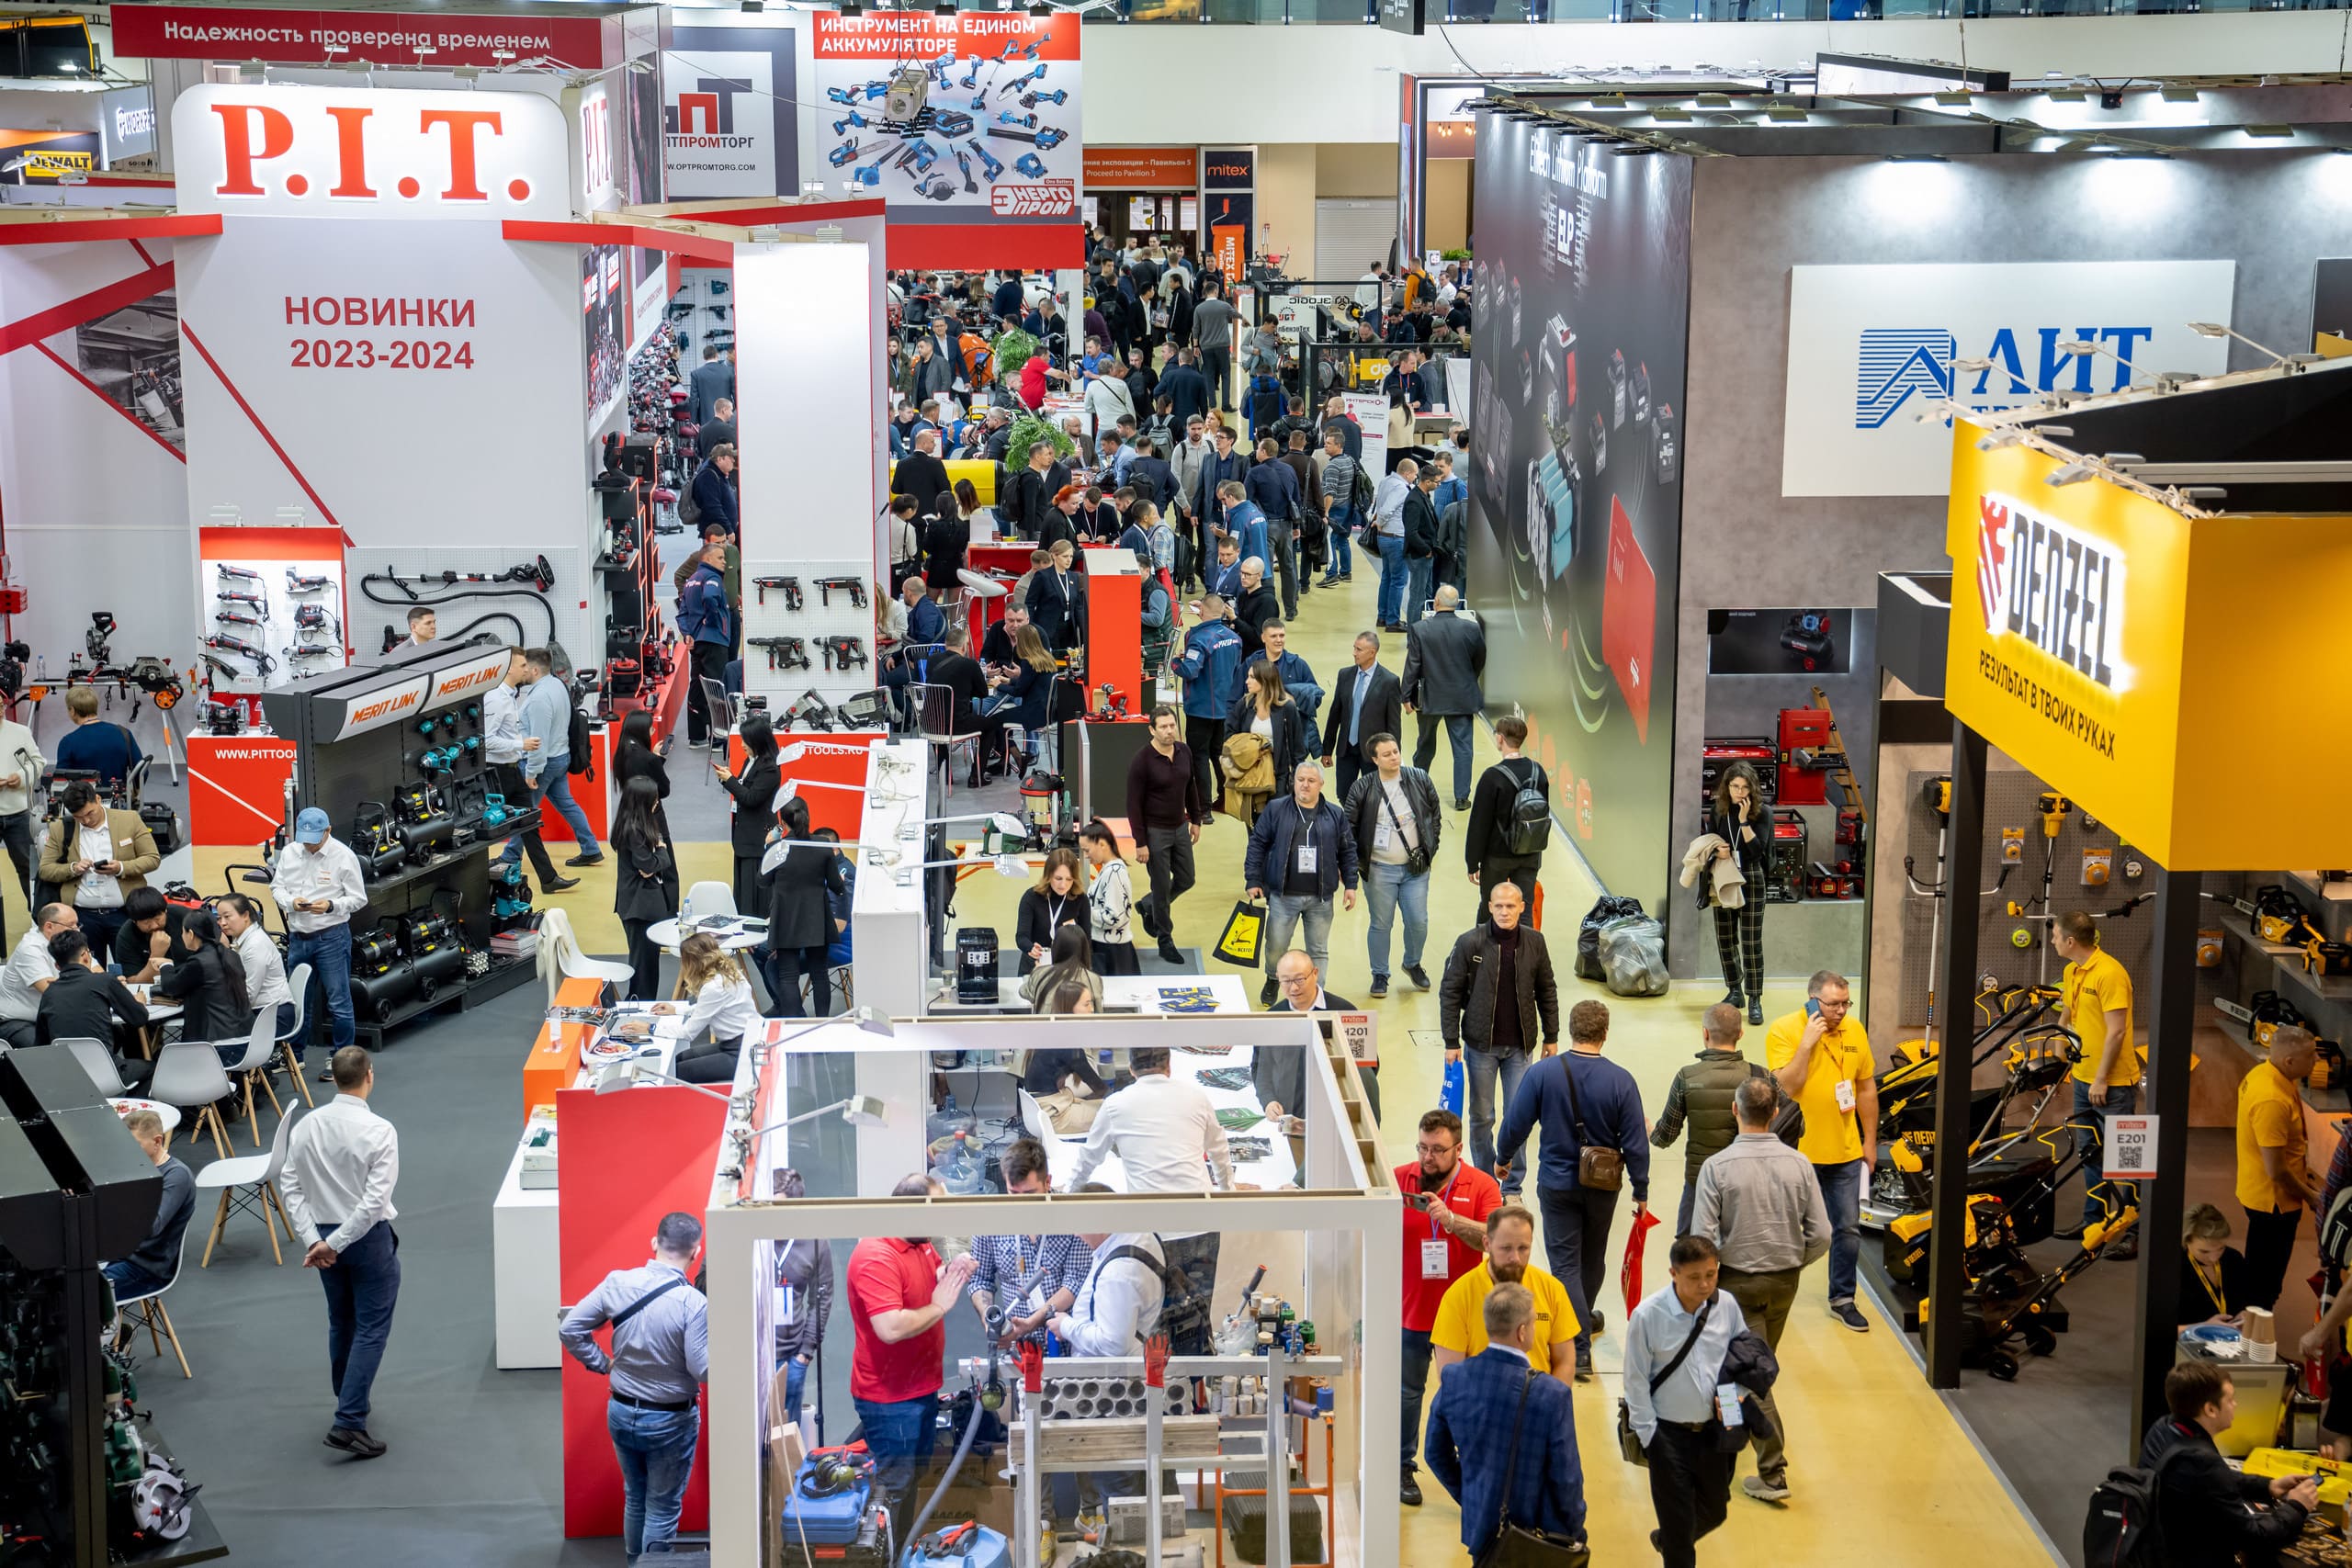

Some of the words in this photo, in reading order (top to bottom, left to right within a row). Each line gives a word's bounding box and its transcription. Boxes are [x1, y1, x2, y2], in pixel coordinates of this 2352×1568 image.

[164, 21, 304, 43] Надежность
[311, 29, 431, 49] проверена
[438, 31, 551, 51] временем
[820, 18, 930, 34] ИНСТРУМЕНТ
[935, 18, 959, 34] НА
[964, 18, 1036, 36] ЕДИНОМ
[820, 38, 957, 52] АККУМУЛЯТОРЕ
[211, 104, 530, 201] P.I.T.
[1124, 169, 1149, 177] Pavilion
[1207, 165, 1249, 176] mitex
[1577, 147, 1607, 200] Platform
[1013, 200, 1073, 215] ПРОМ
[1226, 236, 1236, 270] MITEX
[285, 297, 475, 327] НОВИНКИ
[290, 339, 474, 369] 2023-2024
[2007, 511, 2112, 689] DENZEL
[1979, 649, 2030, 704] РЕЗУЛЬТАТ
[2030, 682, 2038, 709] В
[2040, 687, 2076, 735] ТВОИХ
[2077, 712, 2116, 761] РУКАХ
[2117, 1121, 2146, 1129] mitex
[2117, 1134, 2146, 1144] E201
